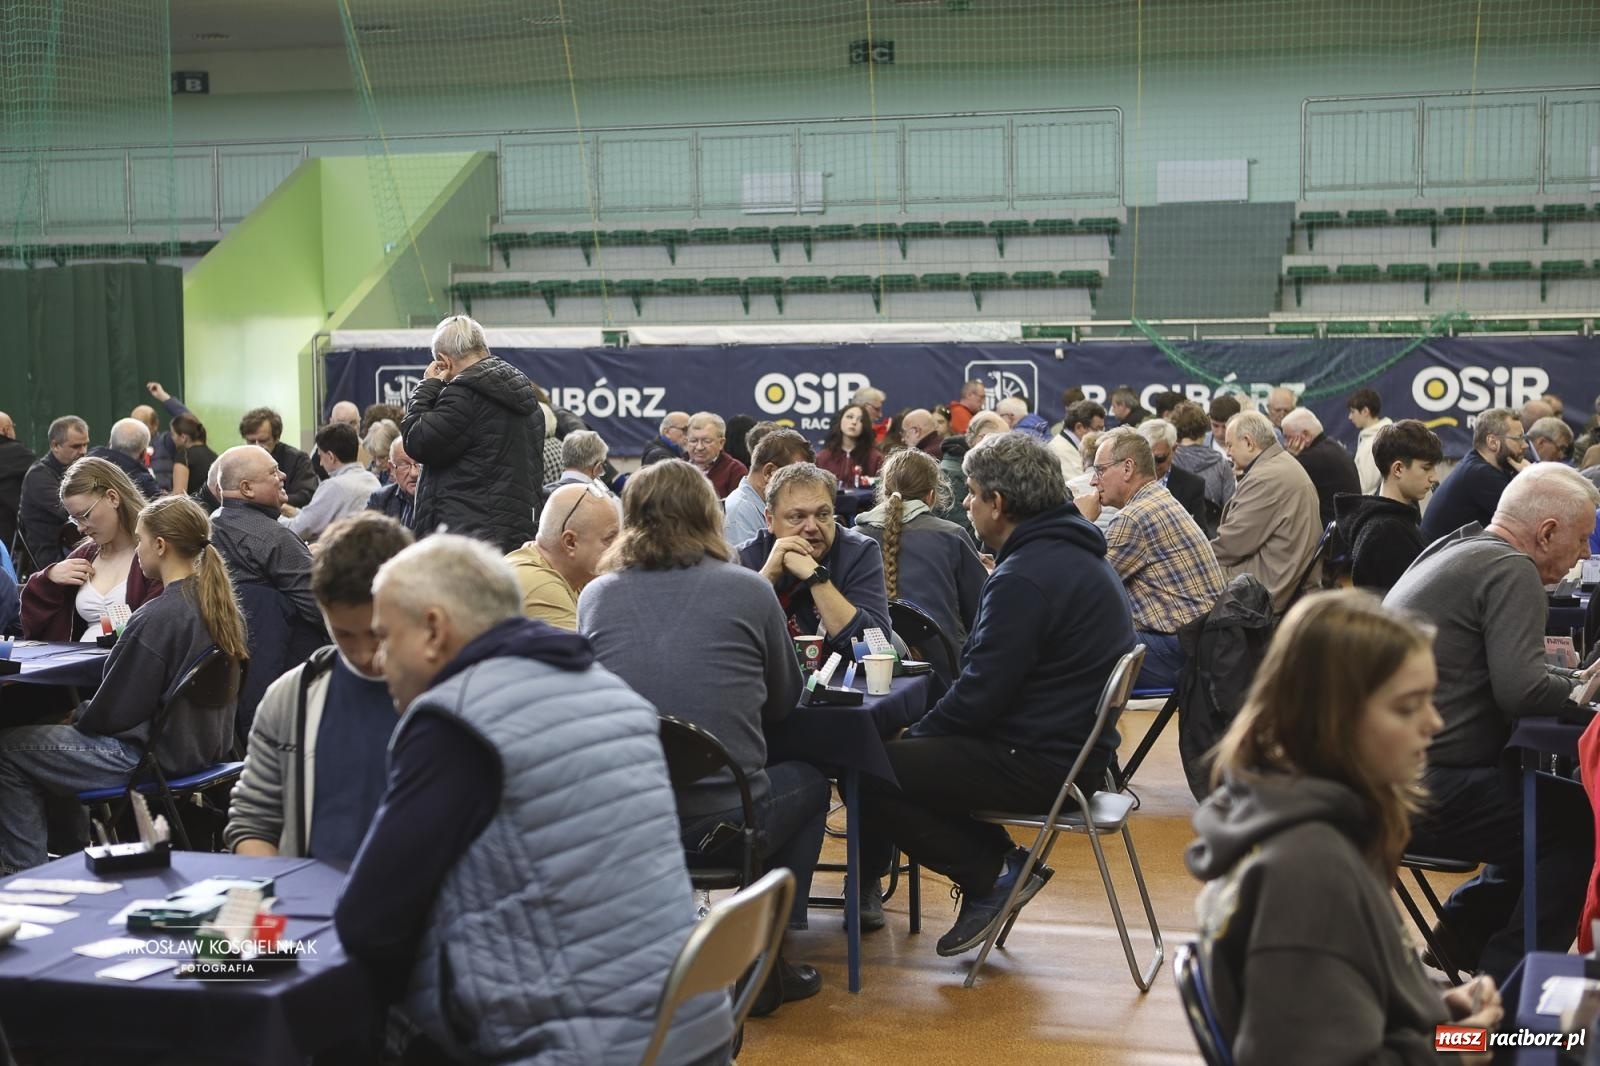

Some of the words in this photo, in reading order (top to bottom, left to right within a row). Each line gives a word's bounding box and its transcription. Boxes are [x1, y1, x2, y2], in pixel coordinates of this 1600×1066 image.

[185, 79, 202, 92] B
[540, 377, 667, 418] IBÓRZ
[1412, 366, 1550, 412] OSiR
[801, 417, 831, 430] RAC
